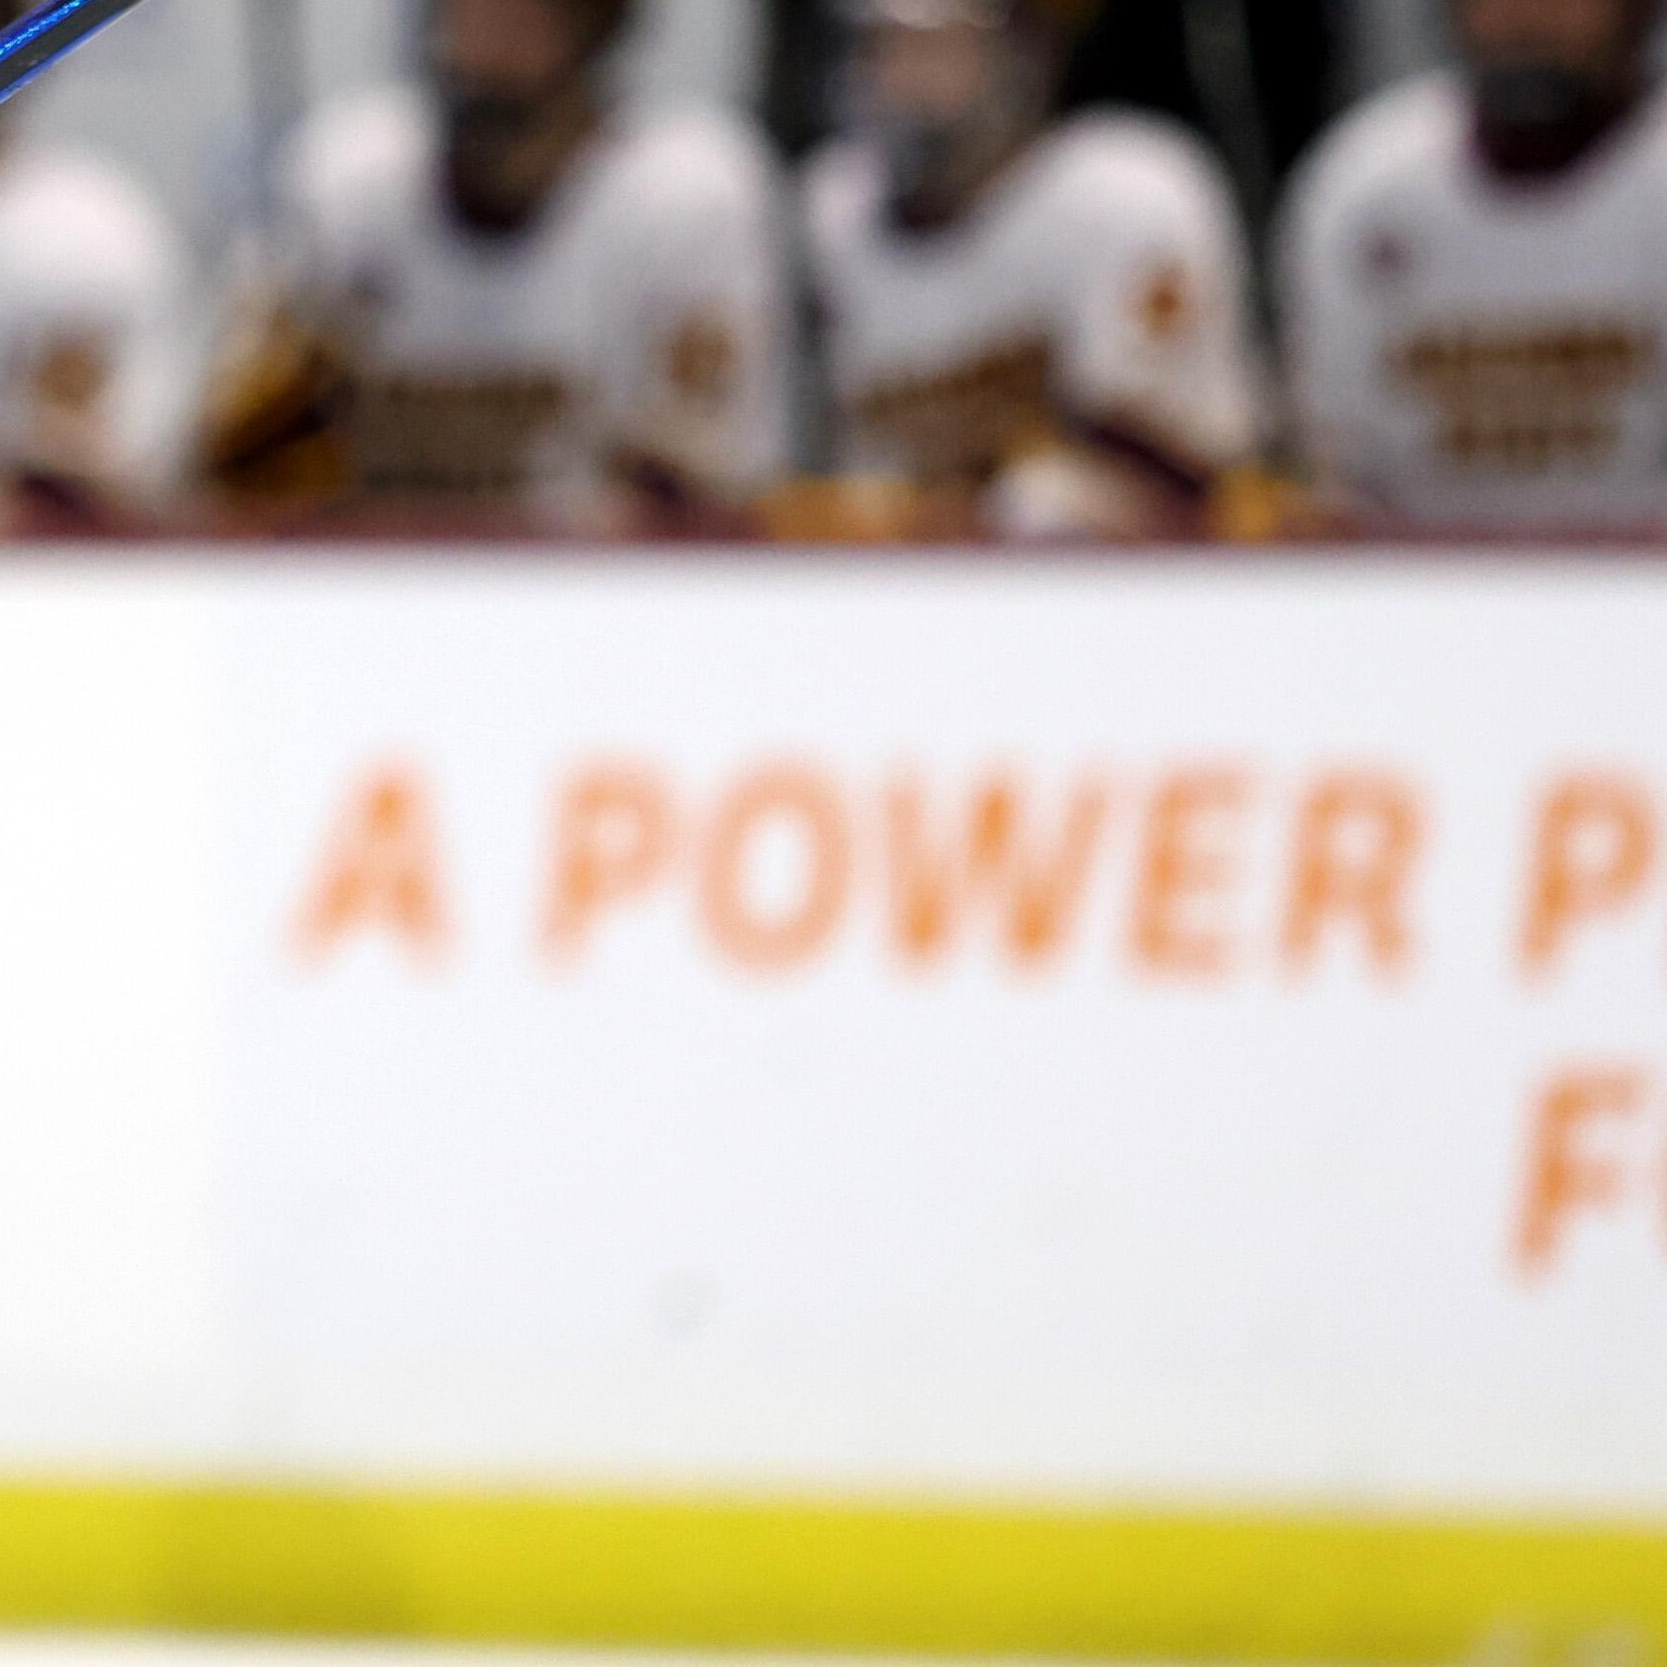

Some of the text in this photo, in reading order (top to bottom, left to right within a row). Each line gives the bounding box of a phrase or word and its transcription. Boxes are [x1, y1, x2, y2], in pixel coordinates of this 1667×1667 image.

[293, 752, 1667, 986] A POWER P
[1509, 1054, 1667, 1289] F
